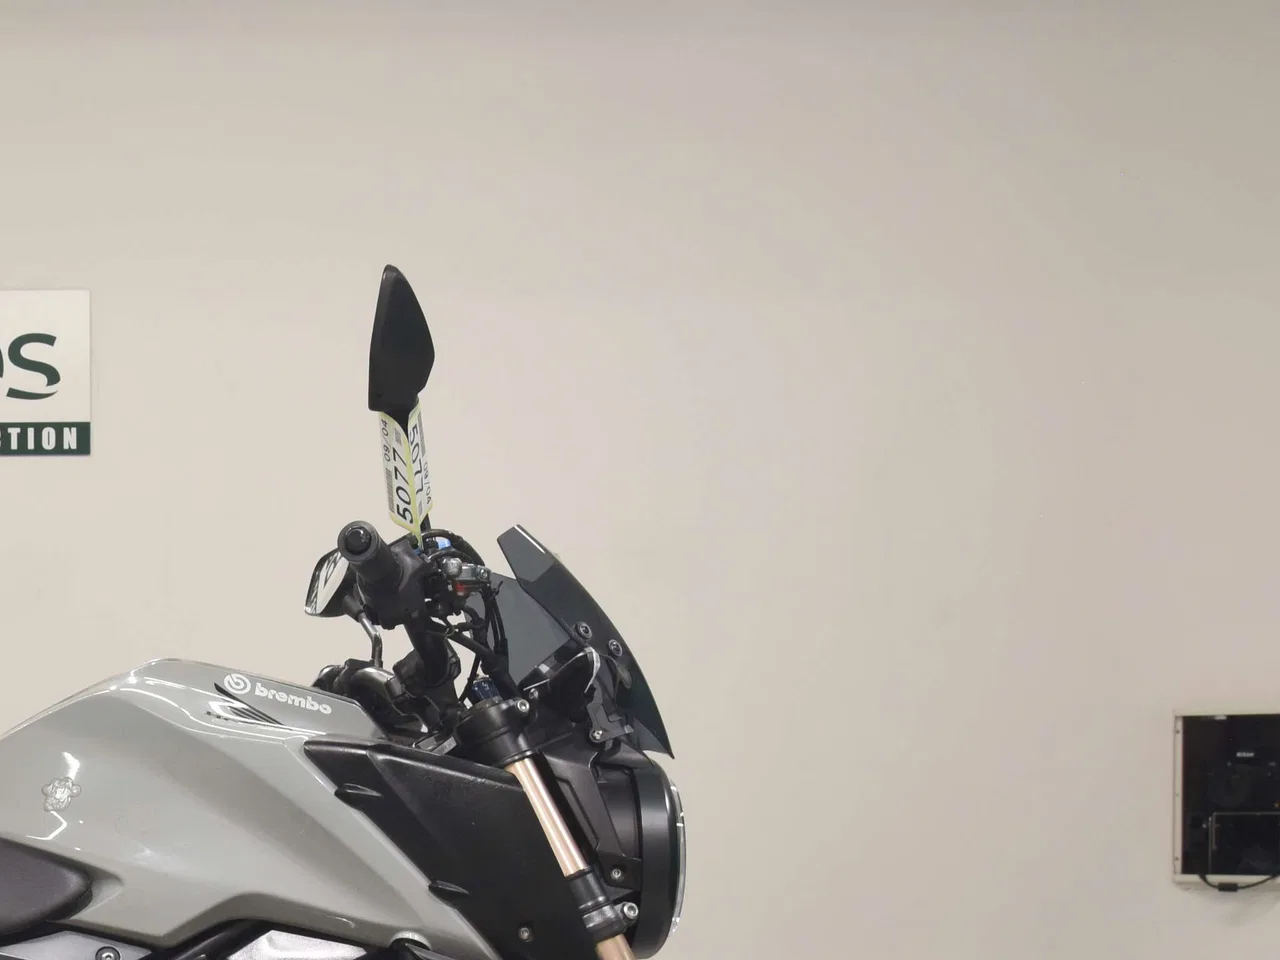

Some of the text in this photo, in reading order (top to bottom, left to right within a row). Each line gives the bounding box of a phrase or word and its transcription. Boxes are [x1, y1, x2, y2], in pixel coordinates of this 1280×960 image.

[381, 419, 391, 462] 09/04
[392, 447, 413, 524] 5077
[254, 682, 332, 715] brembo
